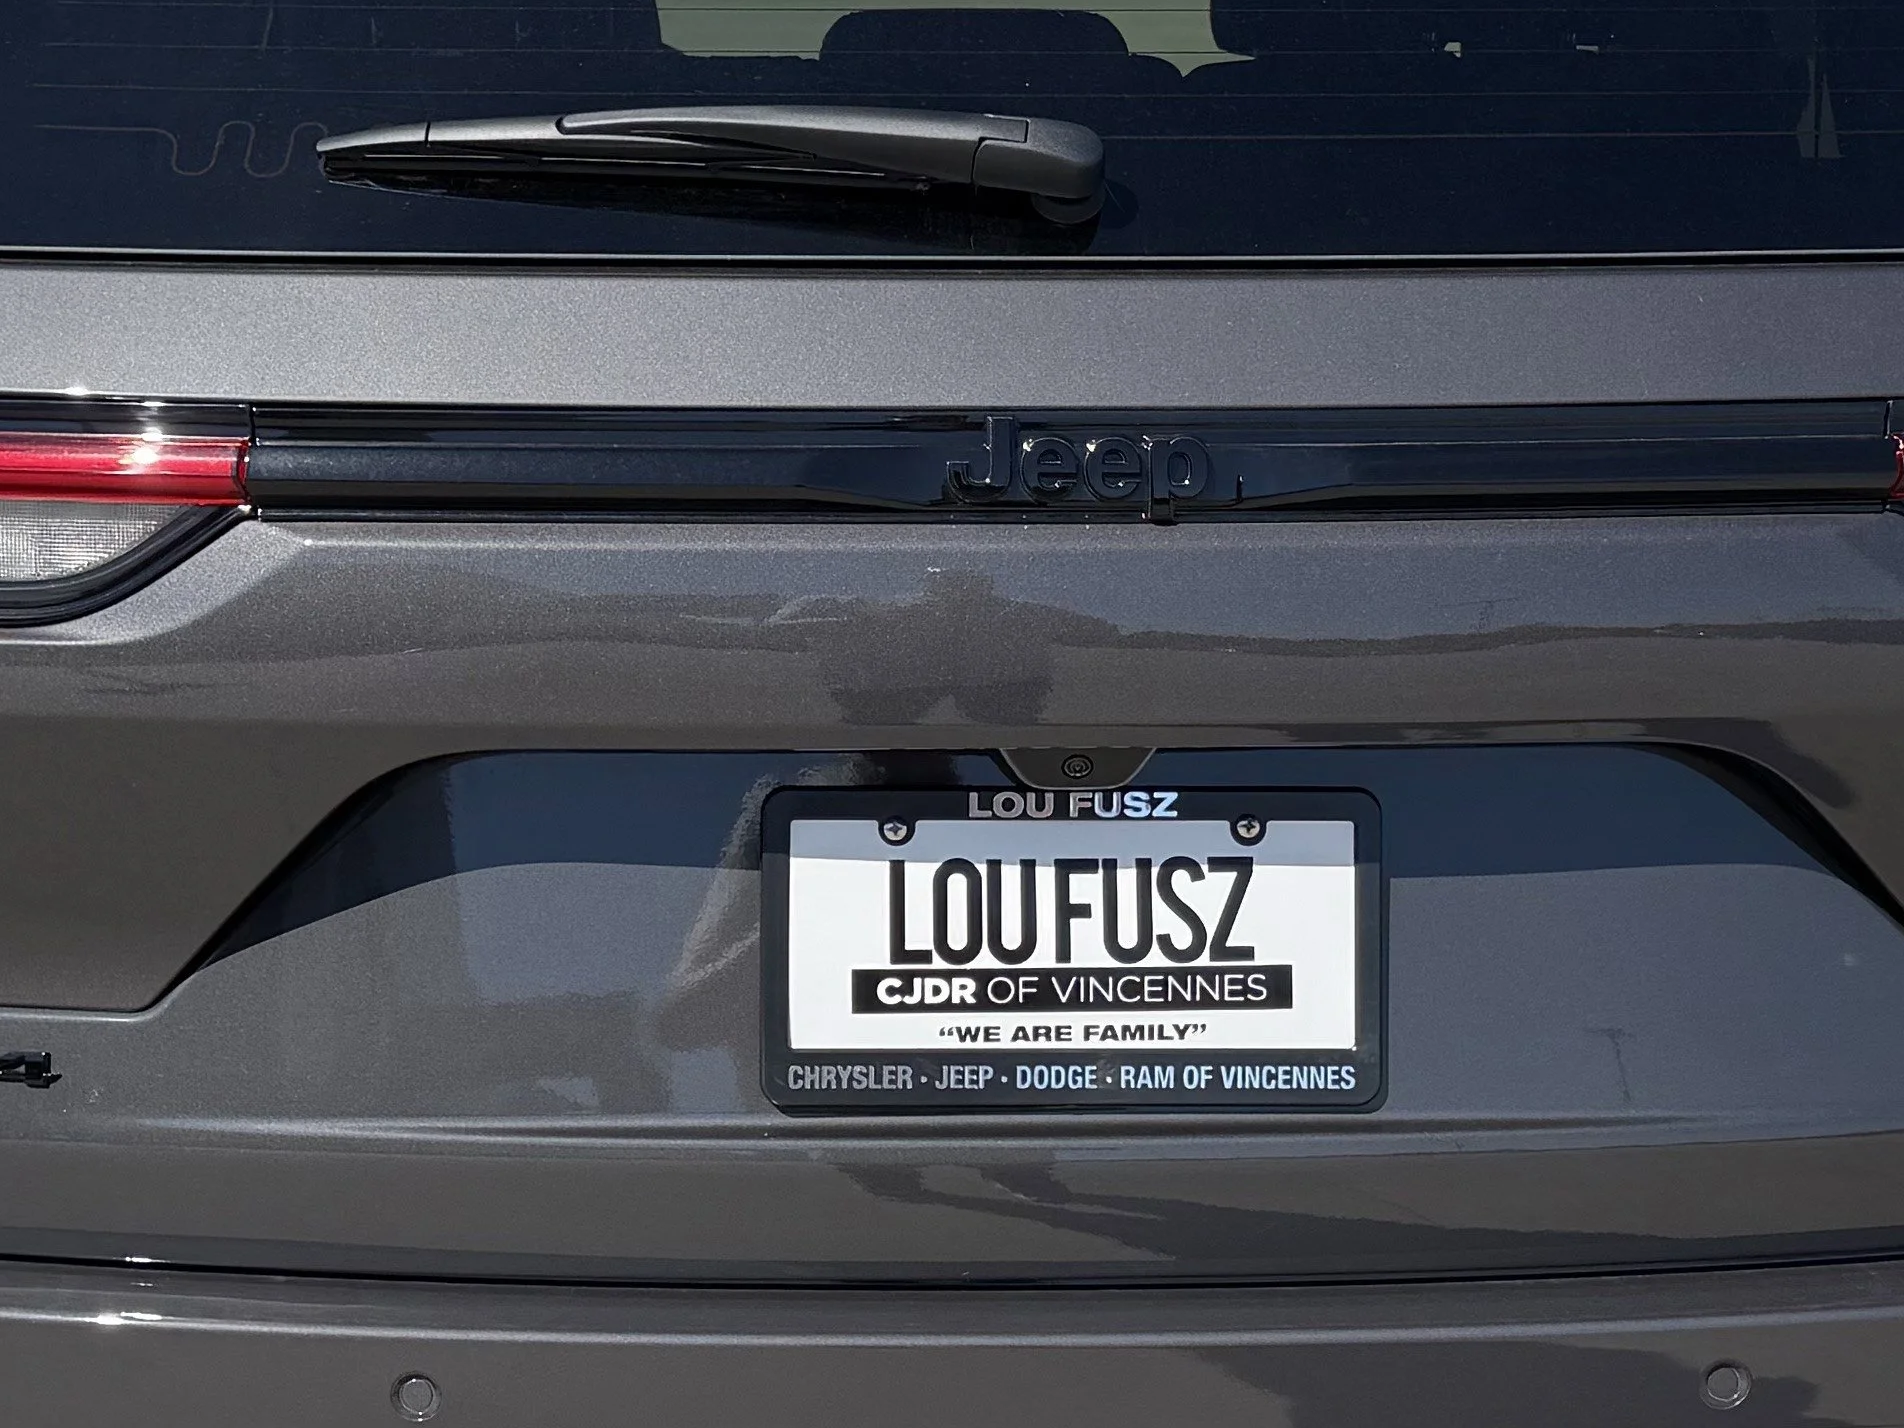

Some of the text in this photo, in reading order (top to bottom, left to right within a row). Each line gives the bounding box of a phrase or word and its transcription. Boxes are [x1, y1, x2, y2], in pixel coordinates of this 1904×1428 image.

[946, 415, 1209, 525] Jeep
[968, 791, 1179, 818] LOU FUSZ
[876, 973, 1268, 1005] CJDR OF VINCENNES
[1010, 1025, 1073, 1042] ARE
[787, 1065, 1356, 1090] CHRYSLER JEEP DODGE RAM OF VINCENNES
